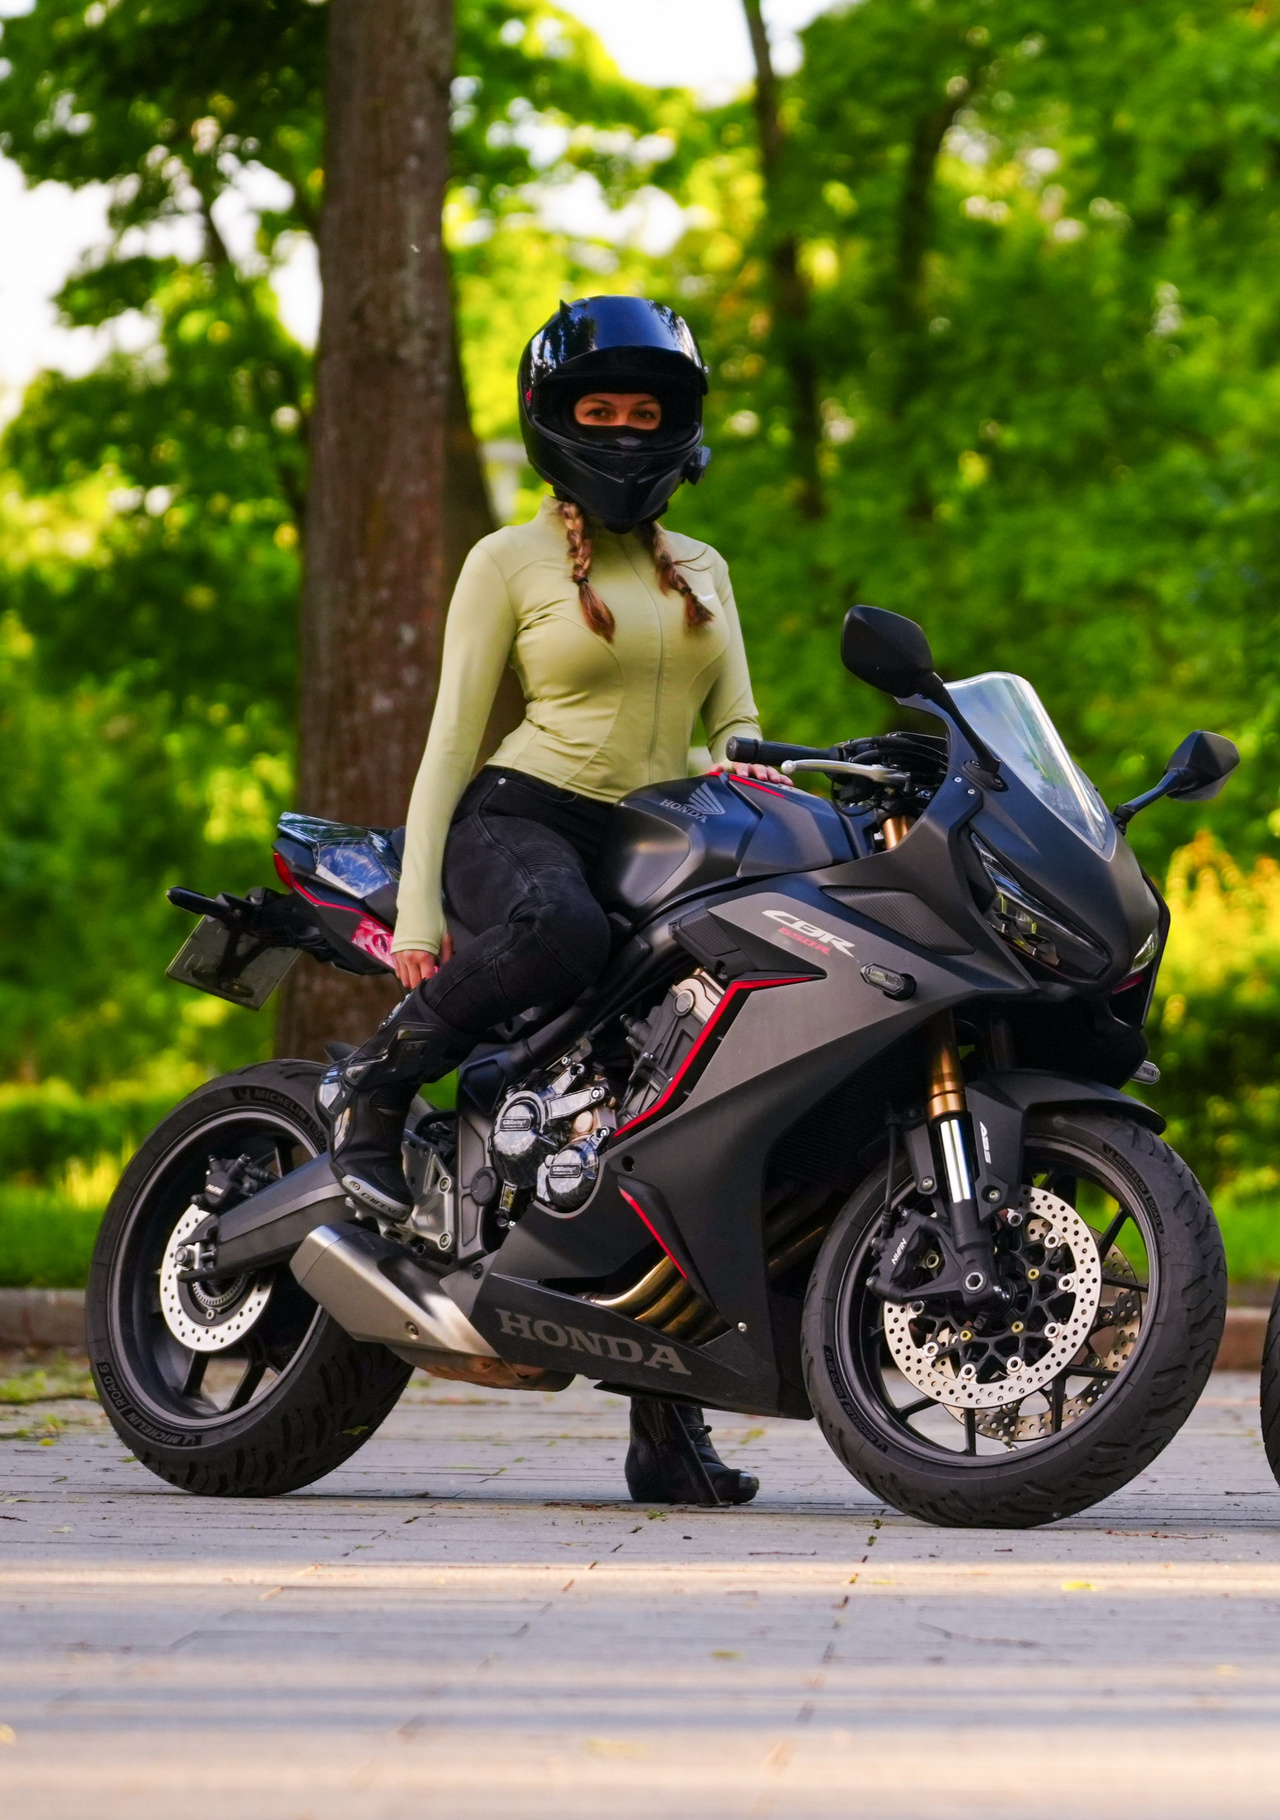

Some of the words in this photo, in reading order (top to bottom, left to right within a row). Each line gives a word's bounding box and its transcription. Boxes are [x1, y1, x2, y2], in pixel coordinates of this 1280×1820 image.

[659, 799, 707, 823] HONDA
[762, 909, 855, 958] CBR
[777, 927, 831, 957] 650R
[254, 1088, 308, 1122] MICHELIN
[979, 1121, 992, 1164] ABS
[1115, 1155, 1148, 1192] MICHELIN
[1148, 1199, 1161, 1223] ROAD
[496, 1308, 692, 1375] HONDA
[99, 1364, 110, 1373] 6
[103, 1376, 125, 1408] ROAD
[126, 1412, 183, 1444] MICHELIN
[845, 1404, 877, 1441] MICHELIN
